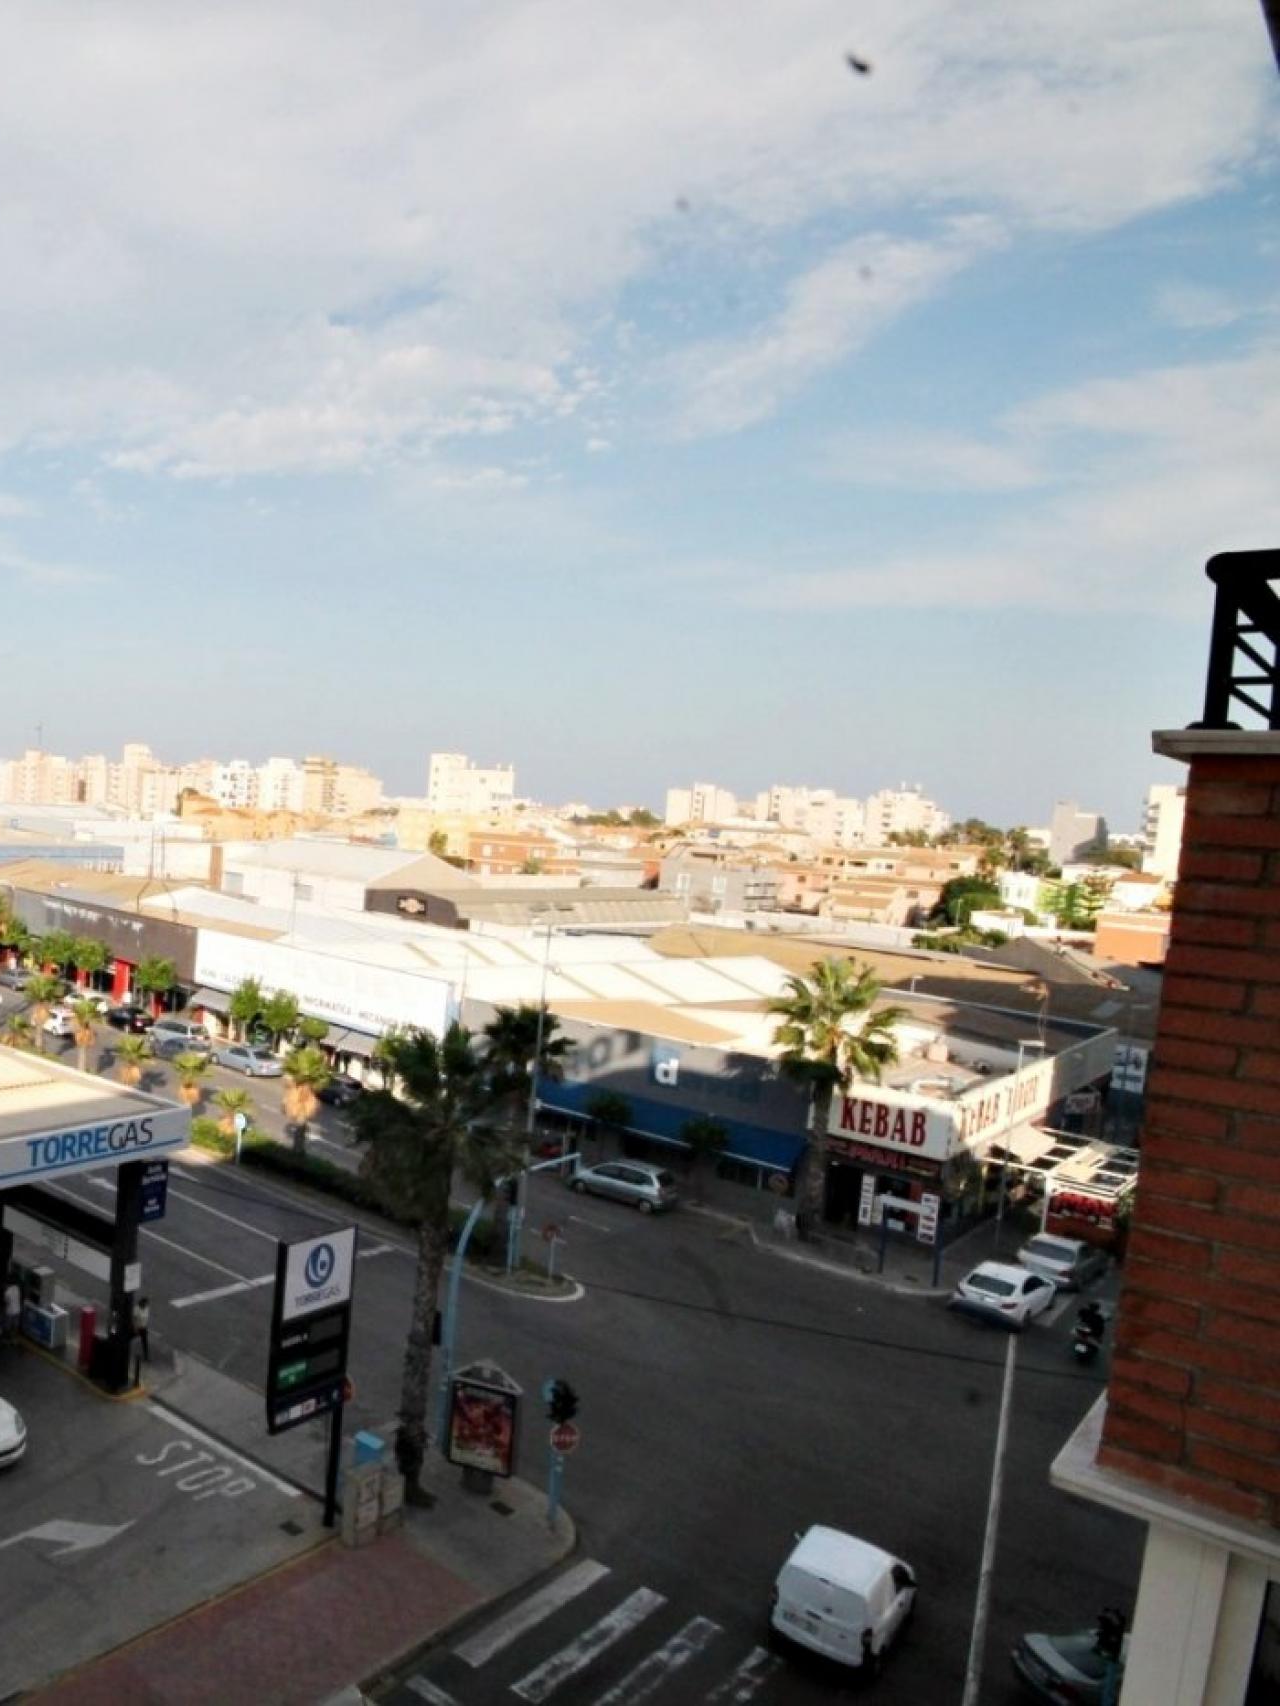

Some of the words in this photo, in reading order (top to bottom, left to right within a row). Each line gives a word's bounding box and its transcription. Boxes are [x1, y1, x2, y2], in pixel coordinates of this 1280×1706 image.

[26, 1117, 154, 1168] TORREGAS
[840, 1095, 927, 1147] KEBAB
[135, 1440, 257, 1502] STOP
